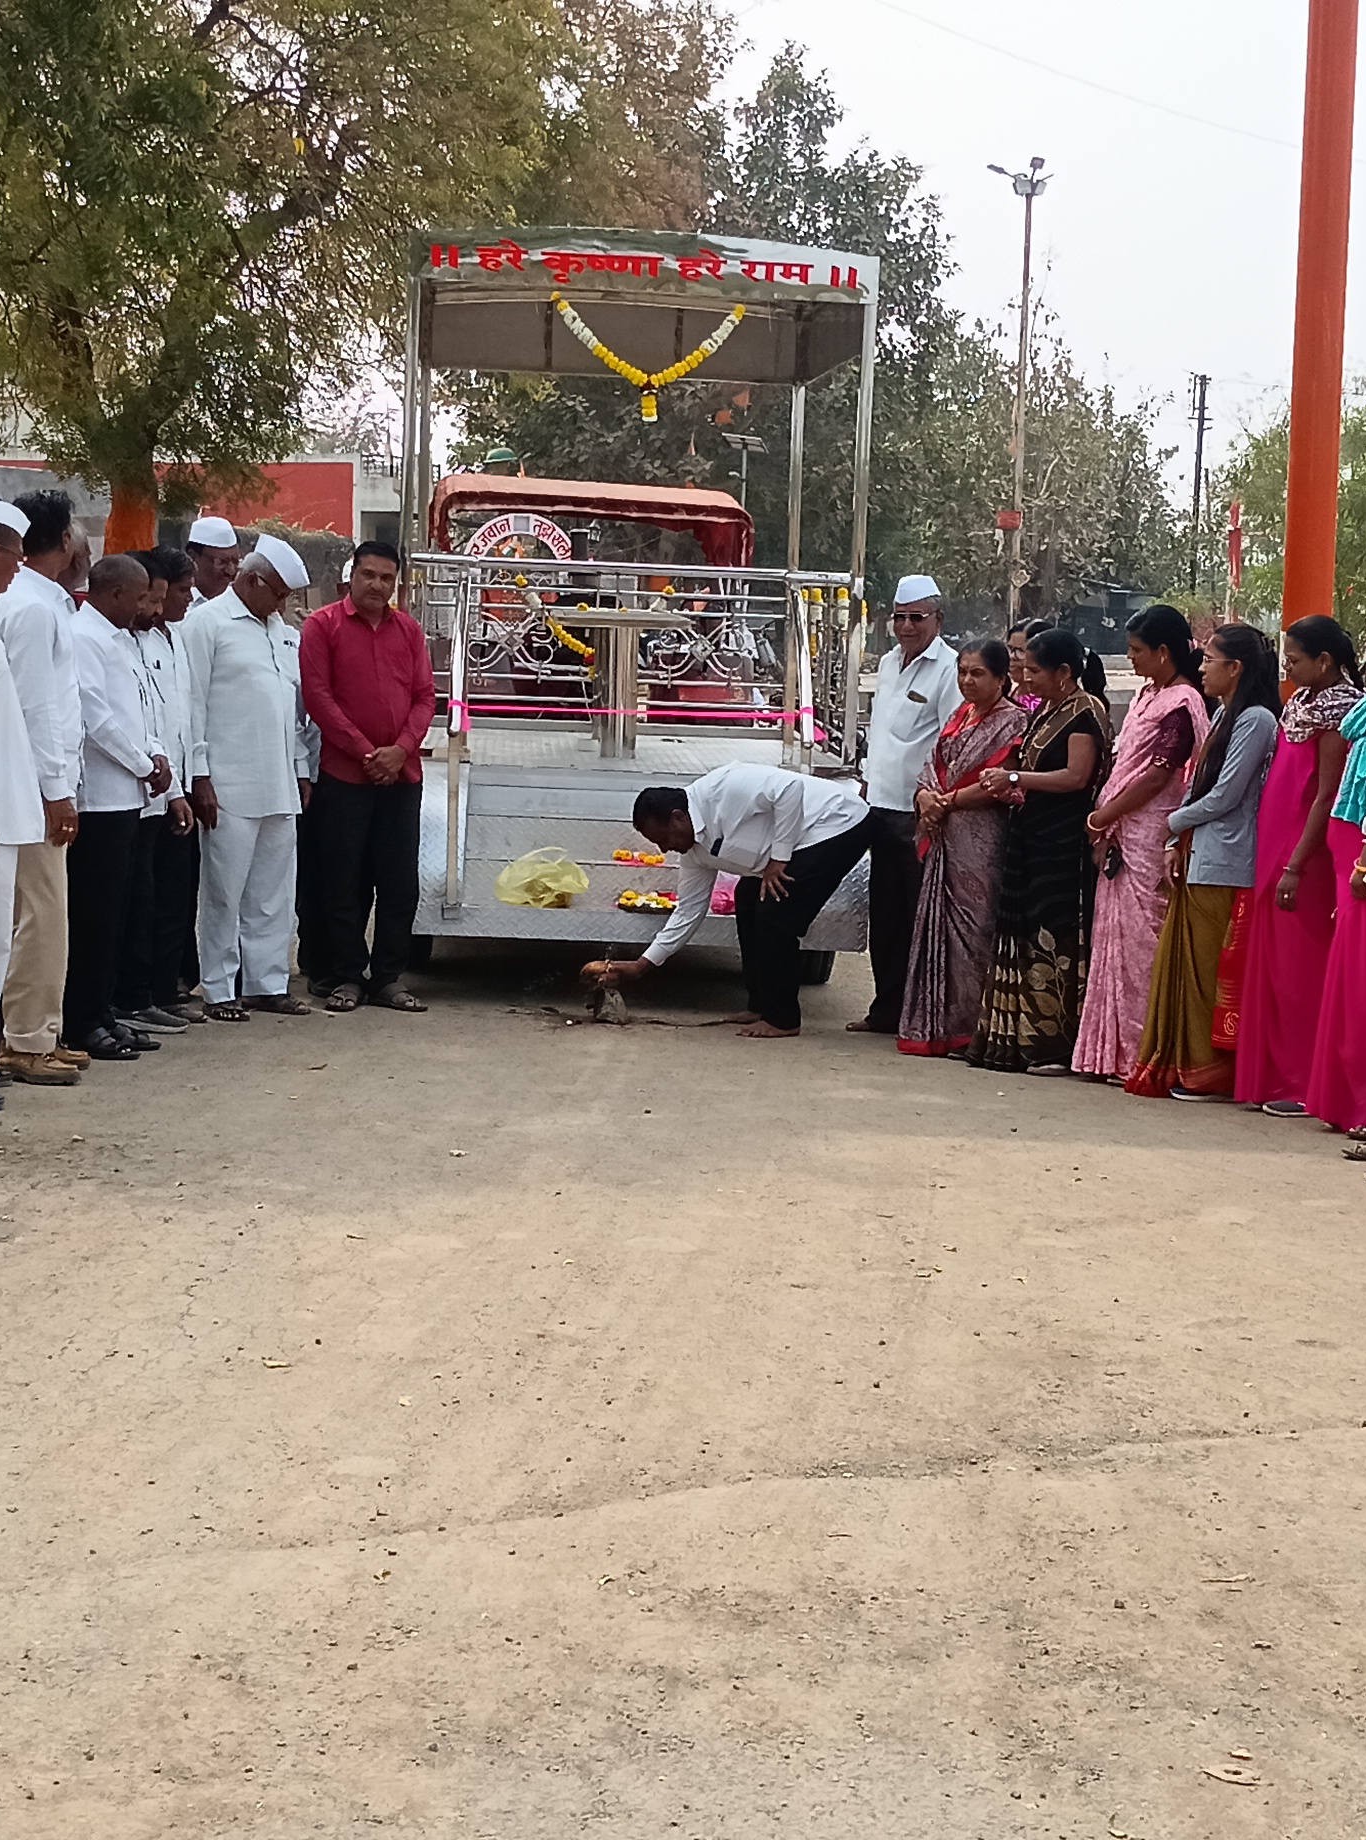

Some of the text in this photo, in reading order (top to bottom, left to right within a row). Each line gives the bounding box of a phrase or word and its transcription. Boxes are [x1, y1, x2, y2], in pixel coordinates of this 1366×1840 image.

[476, 239, 529, 272] हरे
[541, 251, 665, 284] कृष्णा
[676, 248, 727, 282] हरे
[740, 260, 815, 285] राम
[477, 517, 512, 547] जवान
